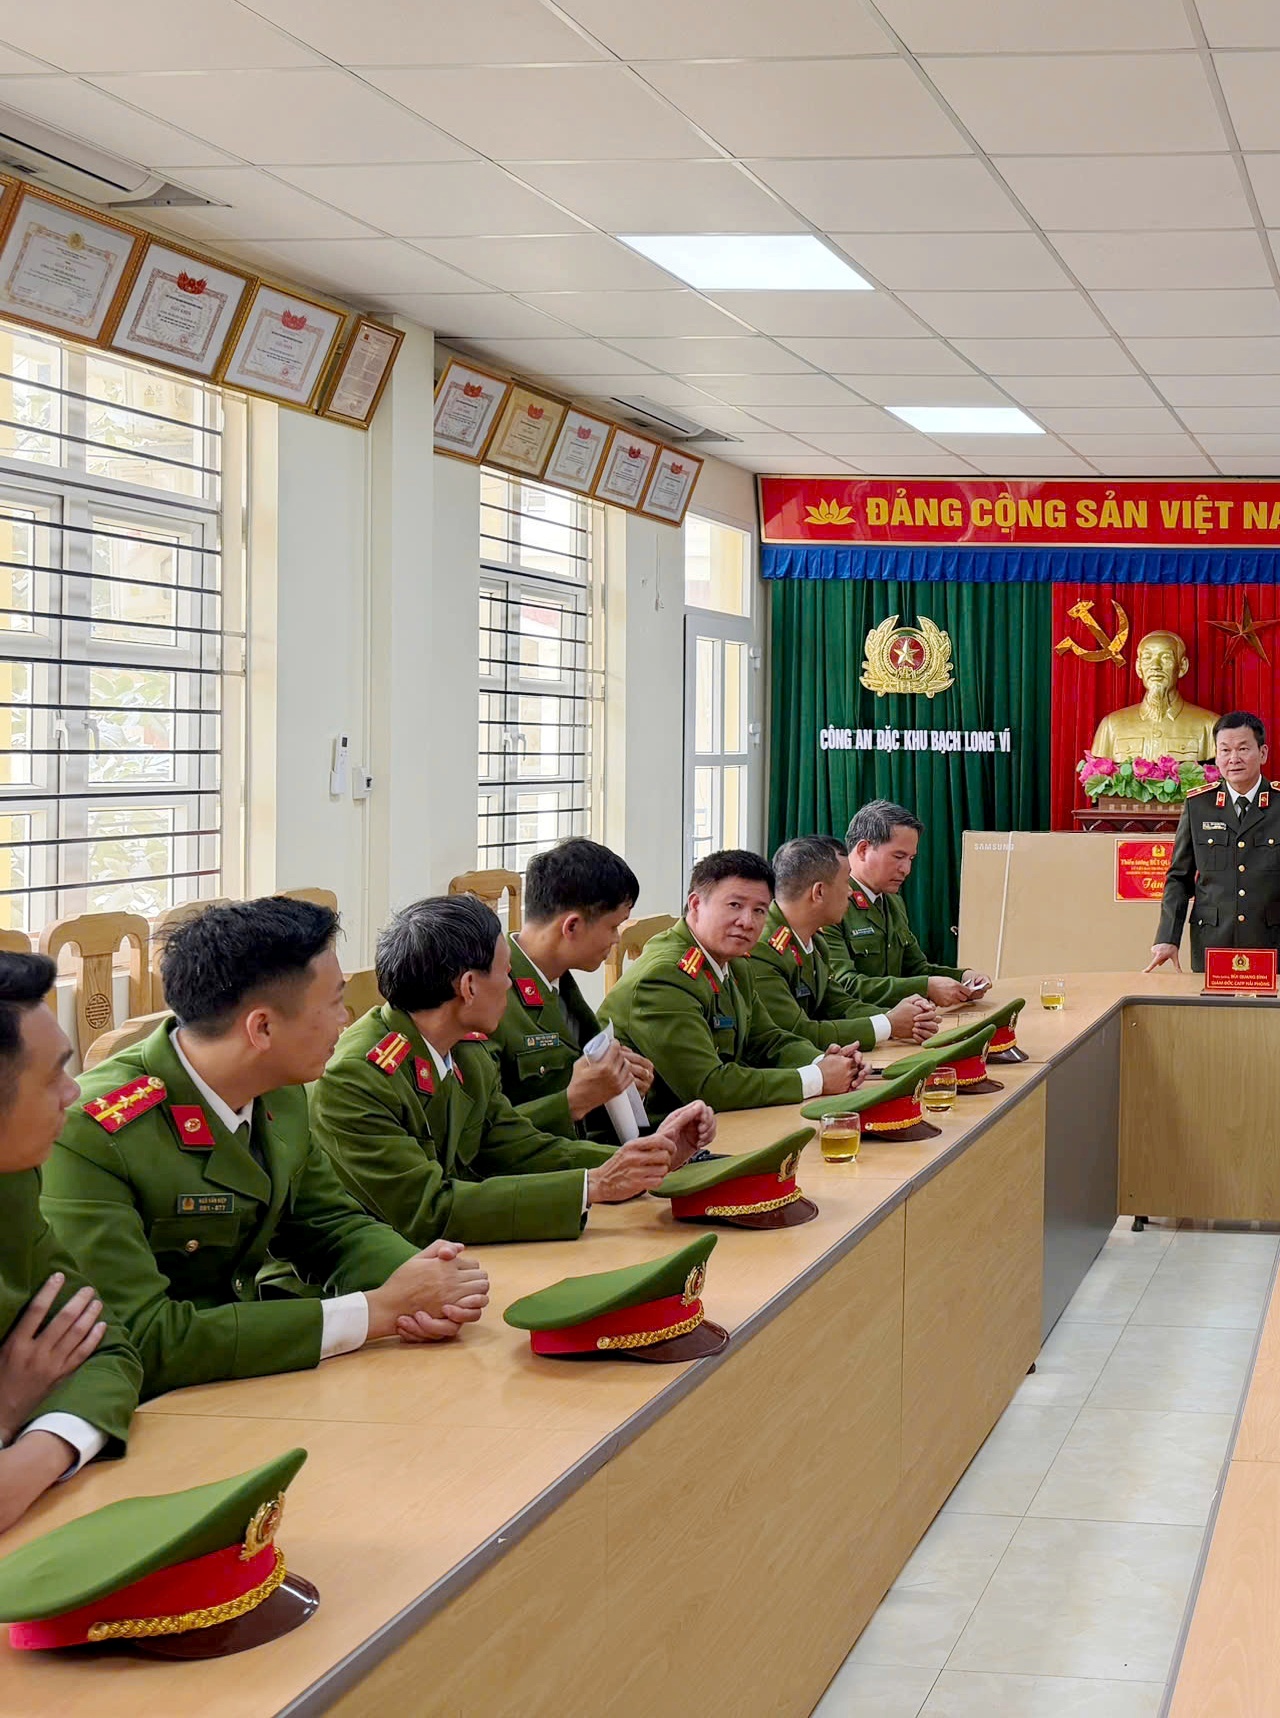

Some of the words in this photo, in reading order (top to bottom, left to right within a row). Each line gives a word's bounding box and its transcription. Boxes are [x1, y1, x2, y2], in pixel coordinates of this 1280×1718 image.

[866, 487, 962, 527] ĐẢNG
[970, 492, 1066, 533] CỘNG
[1075, 490, 1148, 529] SẢN
[1159, 494, 1234, 534] VIỆT
[820, 723, 852, 750] CÔNG
[855, 728, 873, 750] AN
[876, 725, 900, 753] ĐẶC
[904, 730, 928, 751] KHU
[931, 730, 961, 754] BẠCH
[964, 731, 995, 752] LONG
[999, 728, 1011, 753] VĨ
[974, 843, 1014, 851] SAMSUNG
[1142, 877, 1165, 891] Tặn
